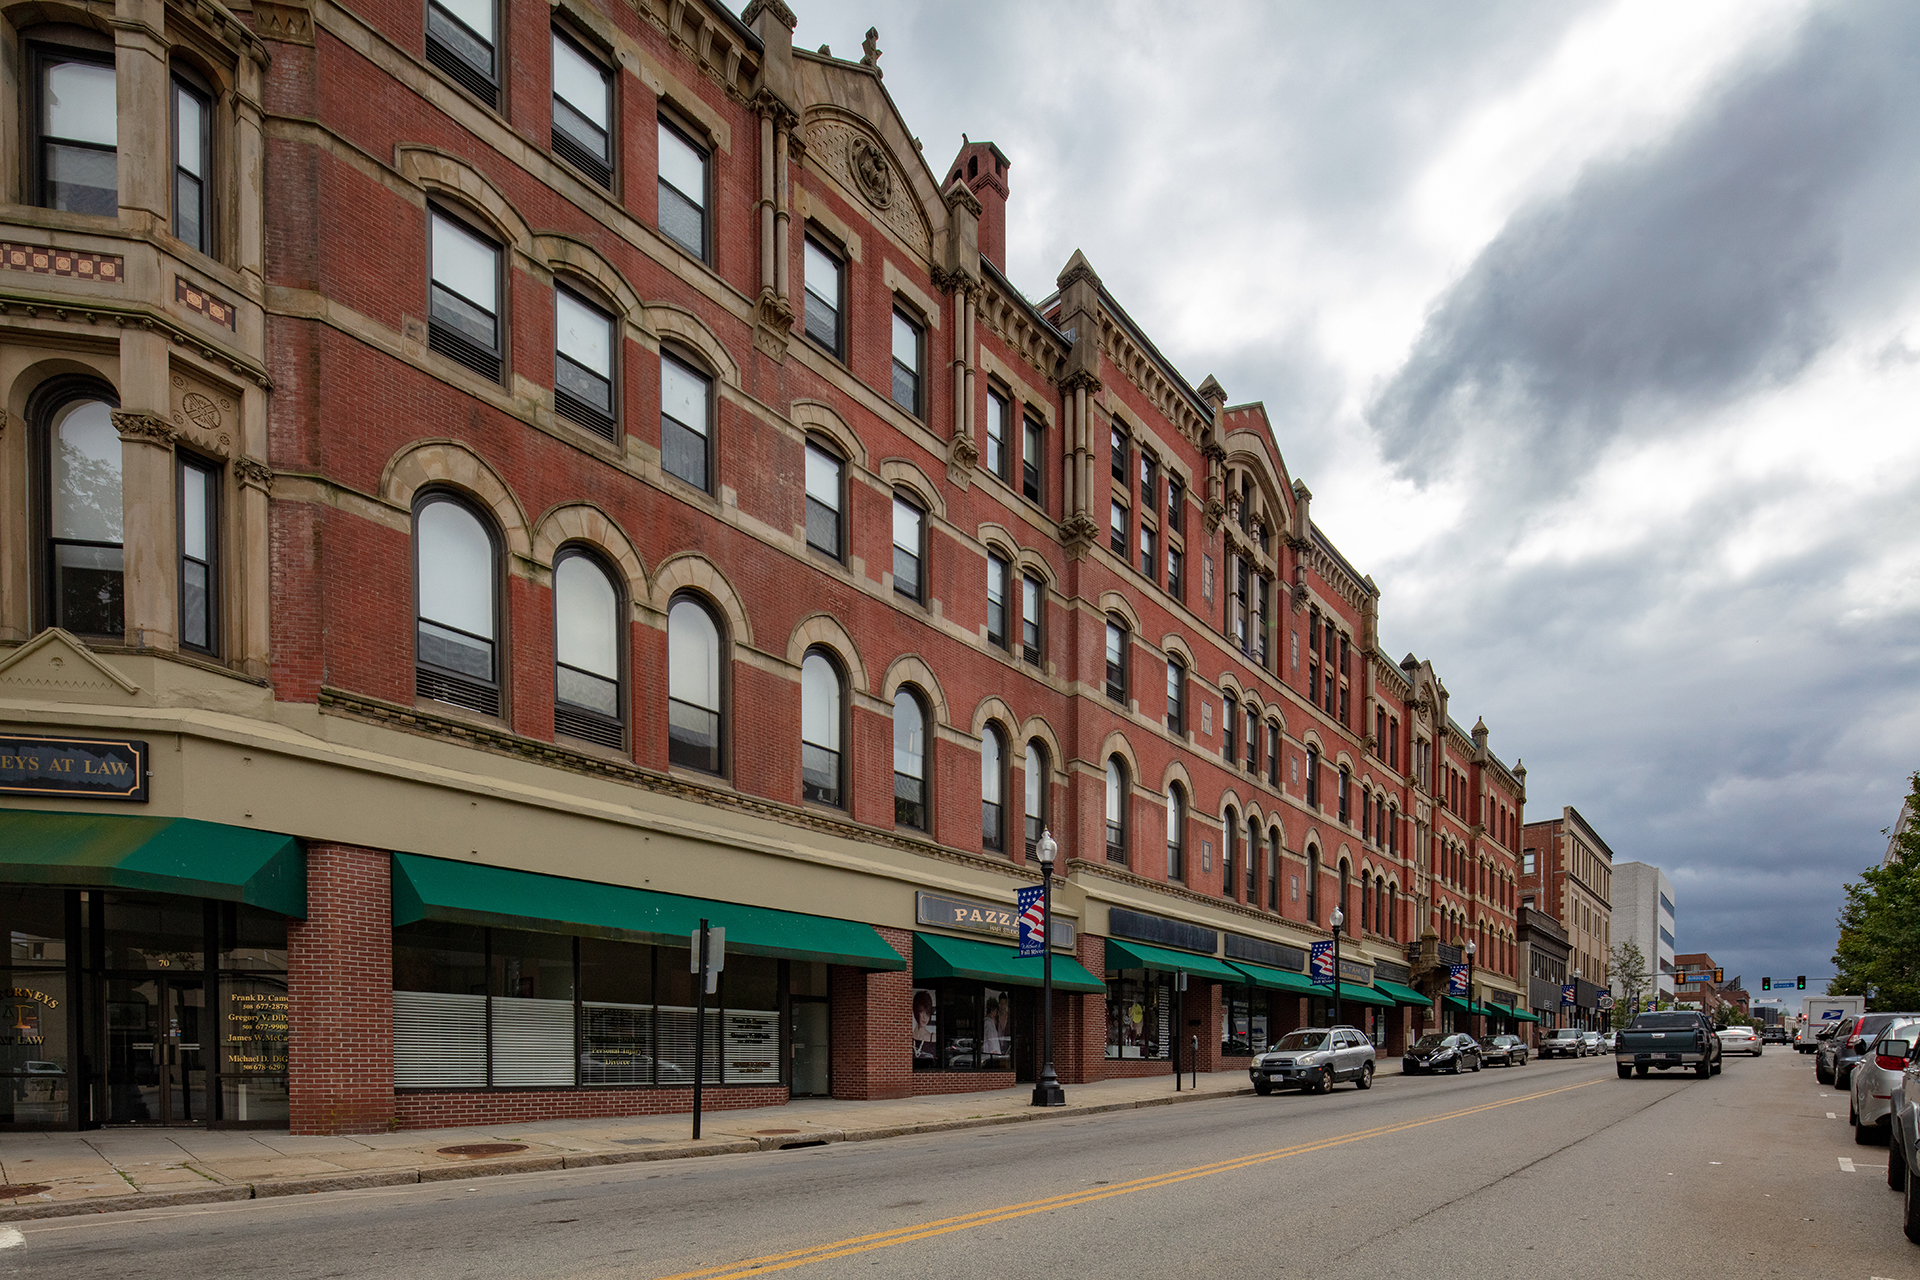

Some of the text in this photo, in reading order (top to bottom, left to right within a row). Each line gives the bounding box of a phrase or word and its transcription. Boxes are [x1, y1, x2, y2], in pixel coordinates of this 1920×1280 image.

[49, 758, 75, 772] AT
[84, 760, 128, 775] LAW
[158, 959, 170, 967] 70
[228, 1013, 259, 1022] Gregory
[17, 1036, 45, 1045] LAW
[227, 1034, 252, 1042] James
